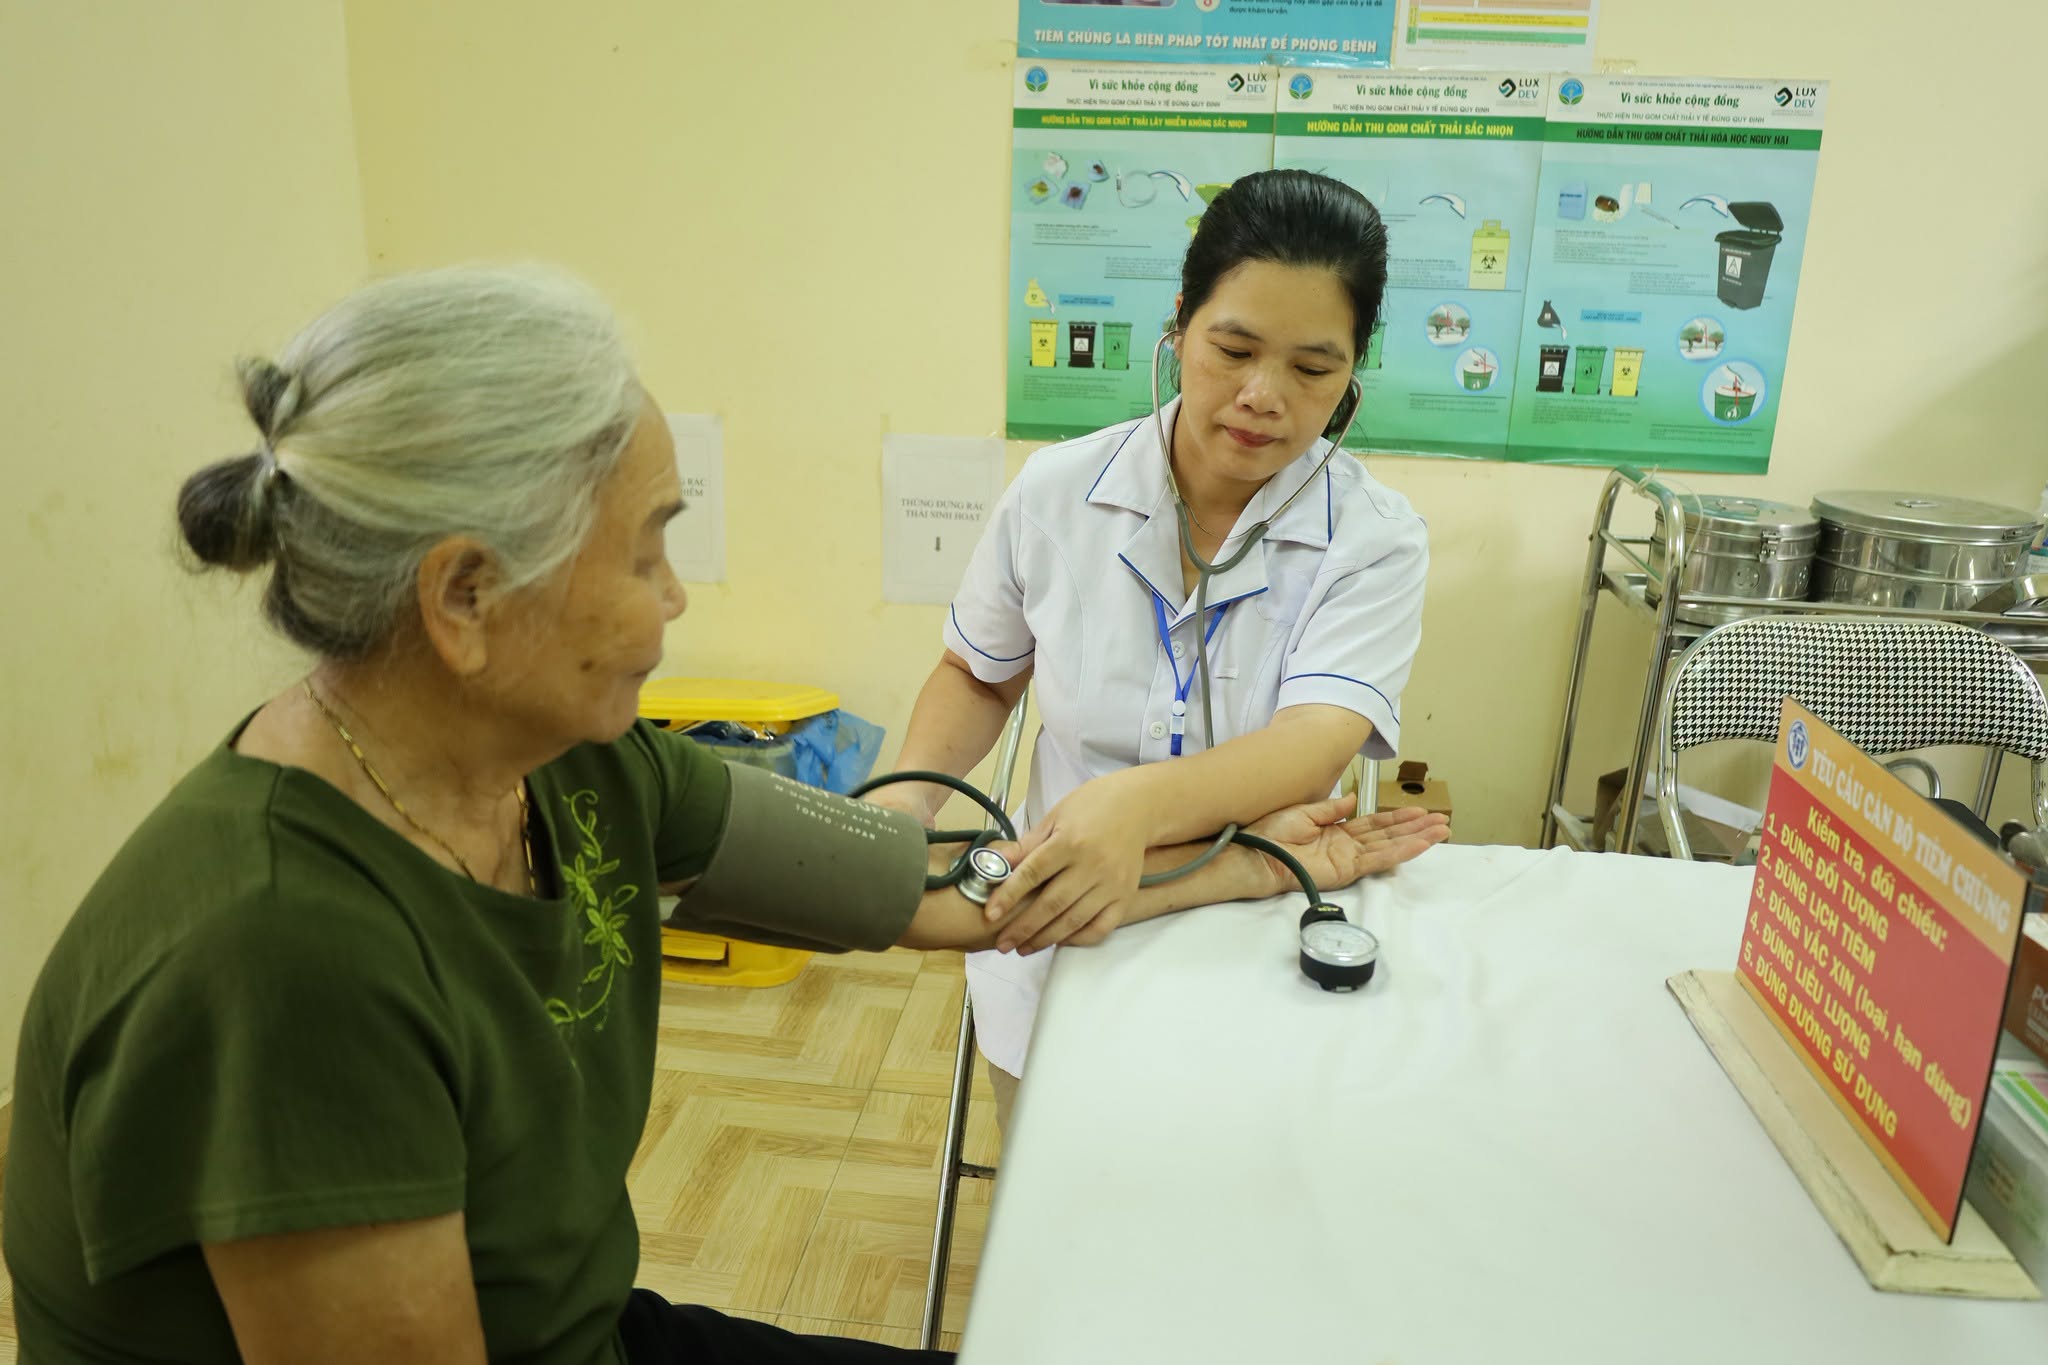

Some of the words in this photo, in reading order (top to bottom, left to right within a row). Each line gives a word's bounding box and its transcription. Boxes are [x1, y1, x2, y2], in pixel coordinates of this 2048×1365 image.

[1247, 73, 1267, 82] LUX
[1519, 78, 1539, 87] LUX
[1246, 84, 1267, 93] DEV
[1518, 89, 1539, 98] DEV
[1795, 87, 1817, 97] LUX
[1621, 92, 1631, 103] Vì
[1634, 93, 1652, 104] sức
[1656, 92, 1681, 104] khỏe
[1685, 94, 1710, 107] cộng
[1714, 93, 1740, 108] đồng
[1794, 98, 1816, 108] DEV
[1307, 120, 1340, 132] HƯỚNG
[1342, 118, 1363, 133] DẪN
[1365, 122, 1384, 133] THU
[1387, 123, 1408, 134] GOM
[1411, 120, 1436, 134] CHẤT
[1440, 121, 1462, 135] THẢI
[1465, 120, 1484, 135] SẮC
[1487, 125, 1514, 138] NHỌN
[796, 803, 832, 825] TOKYO
[841, 823, 876, 841] JAPAN
[1767, 812, 1778, 838] 1.
[1781, 823, 1815, 872] ĐÚNG
[1816, 855, 1840, 895] ĐỐI
[1841, 878, 1889, 944] TƯỢNG
[1808, 806, 1840, 855] Kiểm
[1843, 838, 1867, 884] tra,
[1871, 864, 1896, 904] đối
[1897, 893, 1948, 953] chiếu:
[1761, 844, 1772, 872] 2.
[1775, 857, 1808, 906] ĐÚNG
[1809, 891, 1840, 937] LỊCH
[1841, 921, 1877, 975] TIÊM
[1756, 877, 1766, 904] 3.
[1768, 889, 1802, 939] ĐÚNG
[1829, 955, 1855, 997] XIN
[1893, 1023, 1922, 1073] hạn
[1750, 911, 1760, 936] 4.
[1762, 922, 1795, 973] ĐÚNG
[1823, 993, 1871, 1061] LƯỢNG
[1743, 940, 1753, 968] 5.
[1755, 954, 1788, 1007] ĐÚNG
[1855, 1072, 1898, 1138] DỤNG
